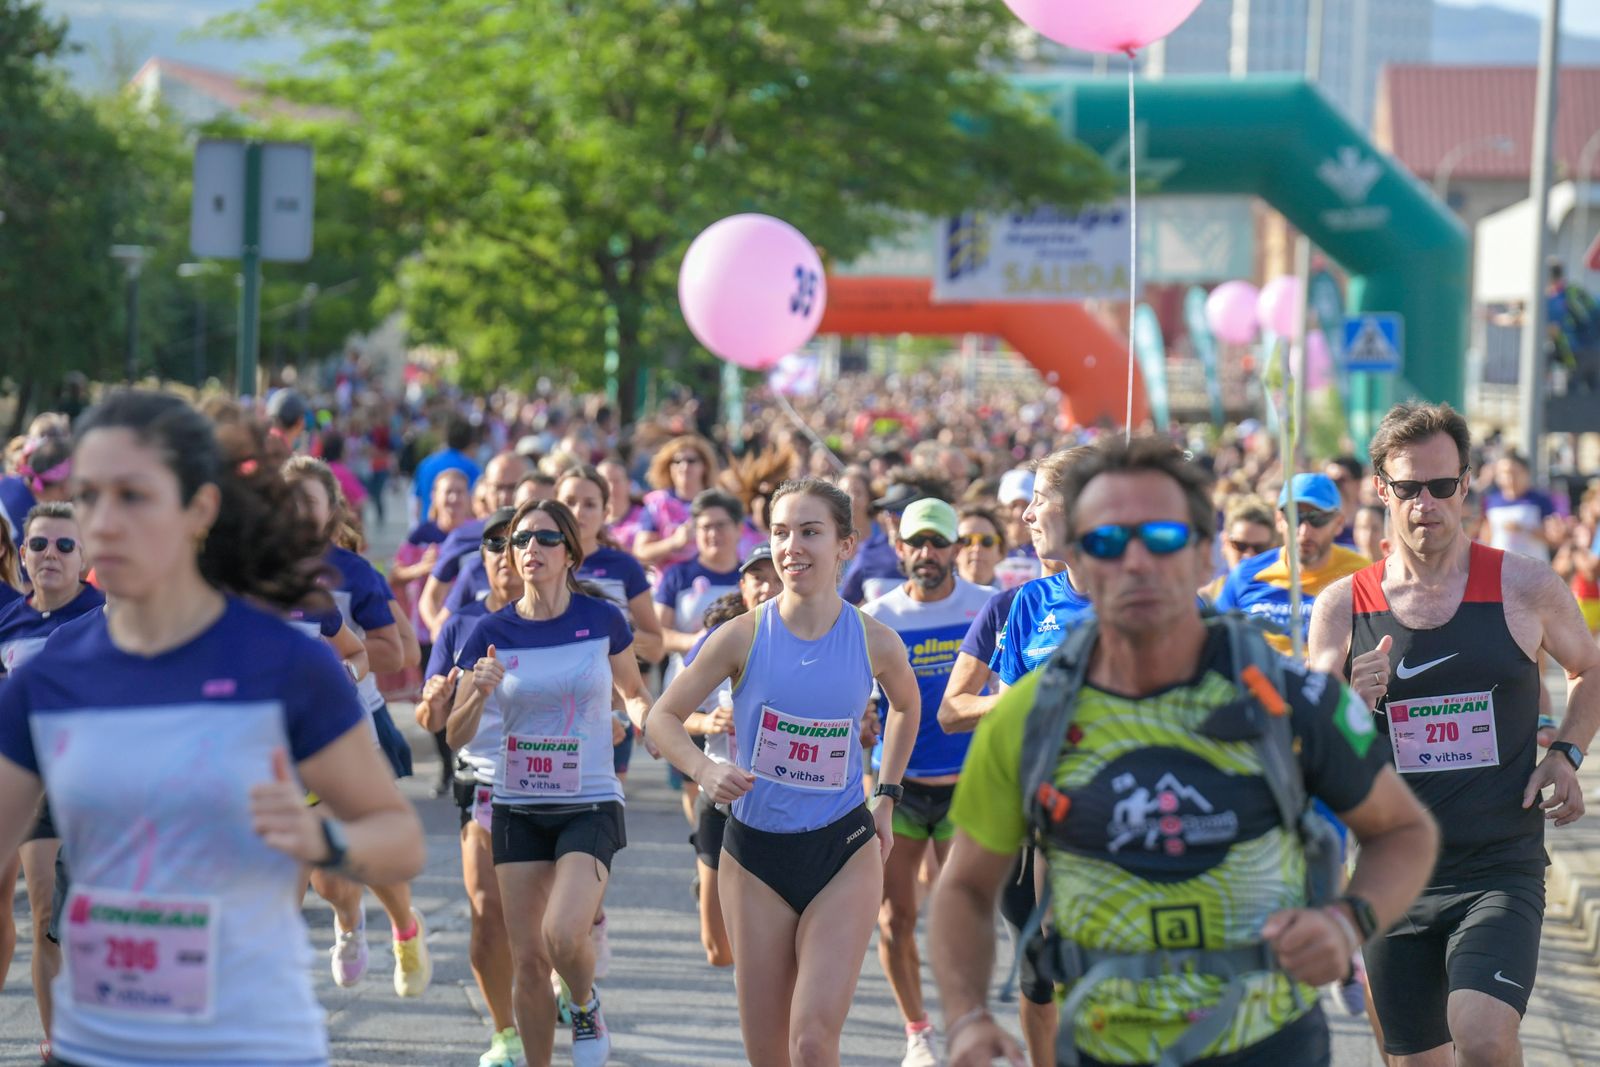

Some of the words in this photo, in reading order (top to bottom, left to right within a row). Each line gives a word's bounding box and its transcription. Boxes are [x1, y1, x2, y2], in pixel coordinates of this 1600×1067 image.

[1004, 263, 1129, 291] SALIDA
[1409, 701, 1488, 718] COVIRAN
[777, 720, 848, 738] COVIRAN
[1425, 722, 1459, 743] 270
[516, 741, 578, 752] COVIRAN
[788, 741, 819, 763] 761
[526, 757, 553, 773] 708
[1434, 751, 1473, 763] vithas
[531, 779, 561, 790] vithas
[790, 770, 825, 783] vithas
